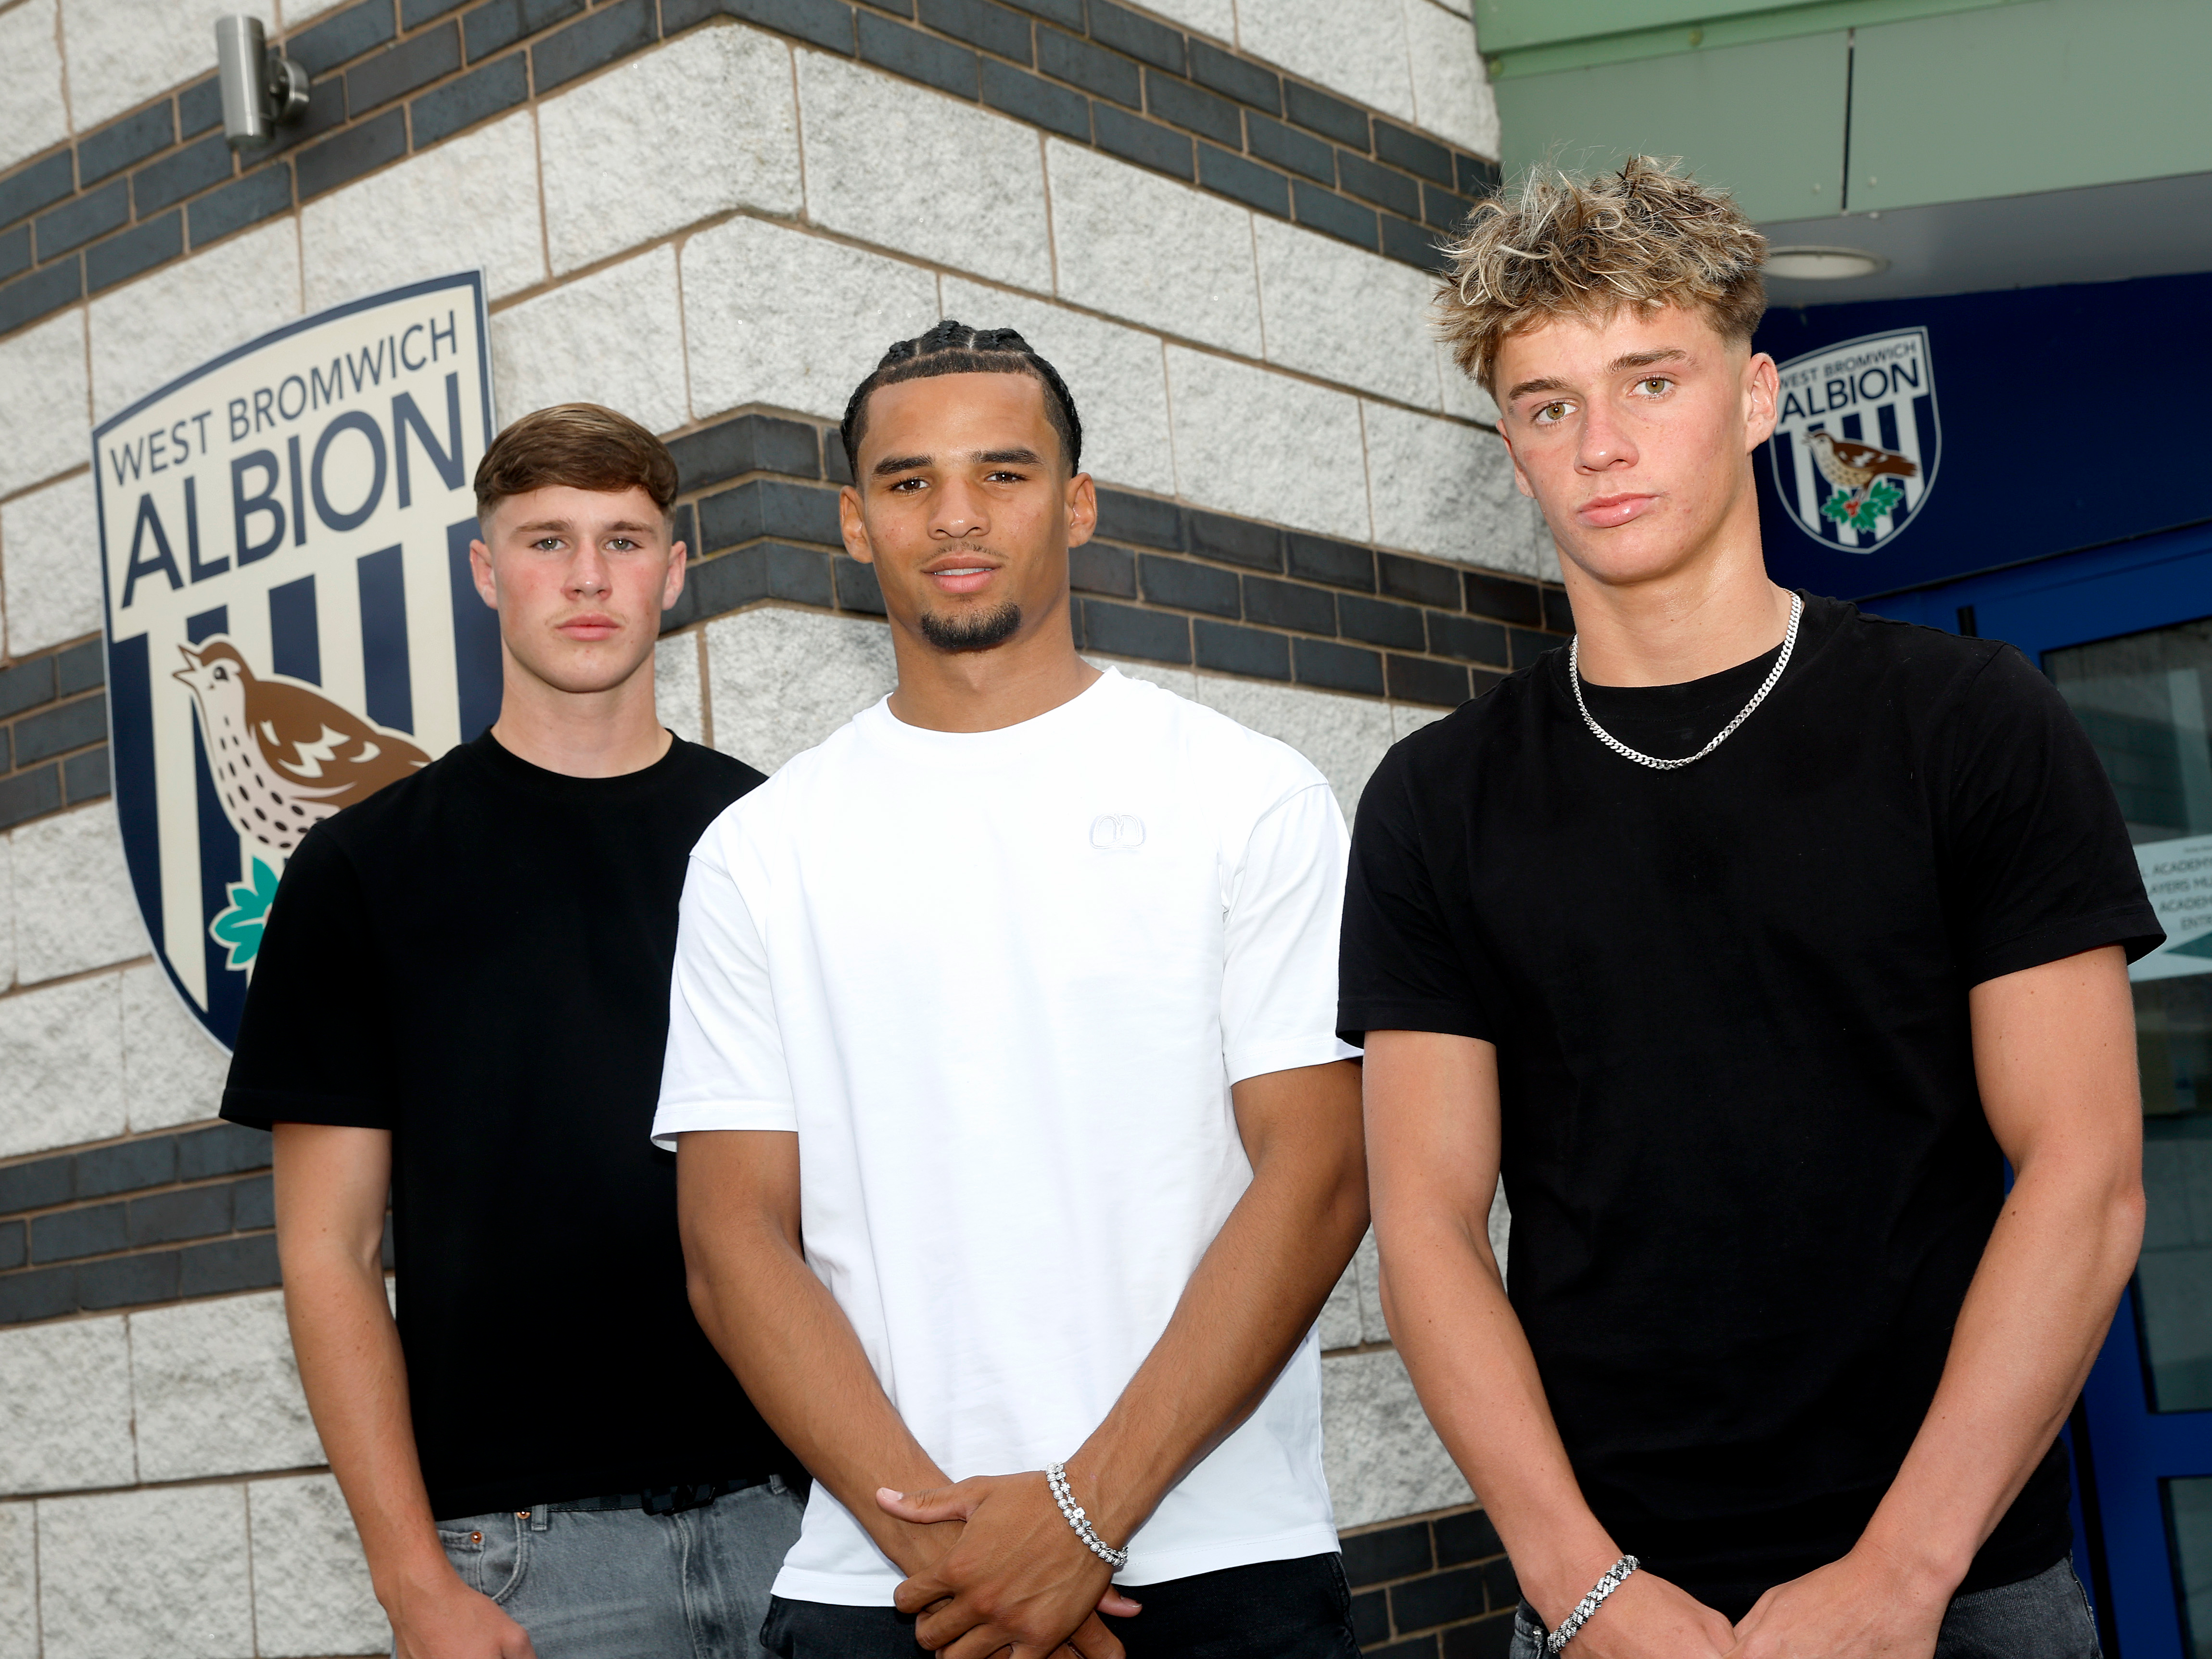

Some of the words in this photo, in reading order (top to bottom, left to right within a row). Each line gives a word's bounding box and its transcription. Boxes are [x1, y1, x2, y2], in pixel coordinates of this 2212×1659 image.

[110, 410, 212, 487] WEST
[228, 309, 457, 442] BROMWICH
[1780, 358, 1919, 424] ALBION
[1823, 340, 1917, 378] BROMWICH
[120, 371, 466, 610] ALBION
